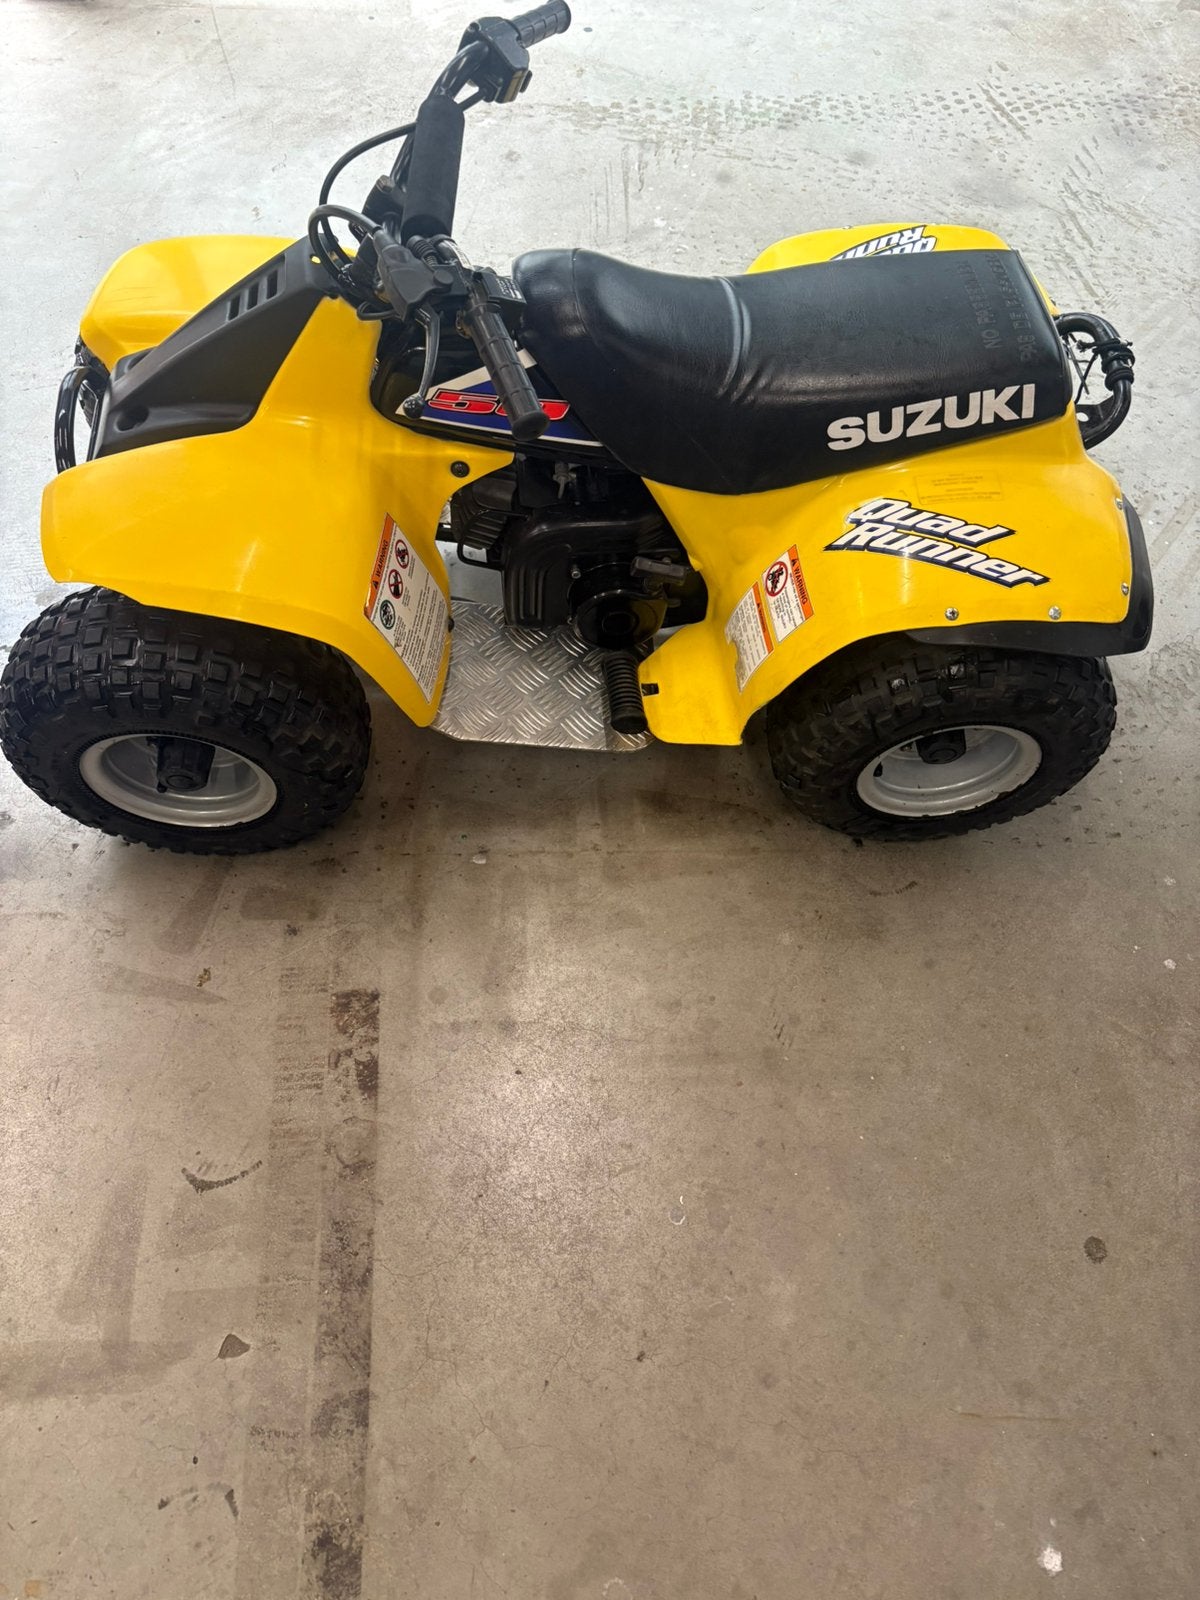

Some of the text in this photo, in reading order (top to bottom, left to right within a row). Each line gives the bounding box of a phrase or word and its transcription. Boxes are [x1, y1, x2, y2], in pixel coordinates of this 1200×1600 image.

[826, 383, 1036, 451] SUZUKI
[845, 498, 1016, 548] Quad
[374, 539, 389, 578] WARNING
[825, 521, 1050, 587] Runner
[793, 567, 809, 606] WARNING
